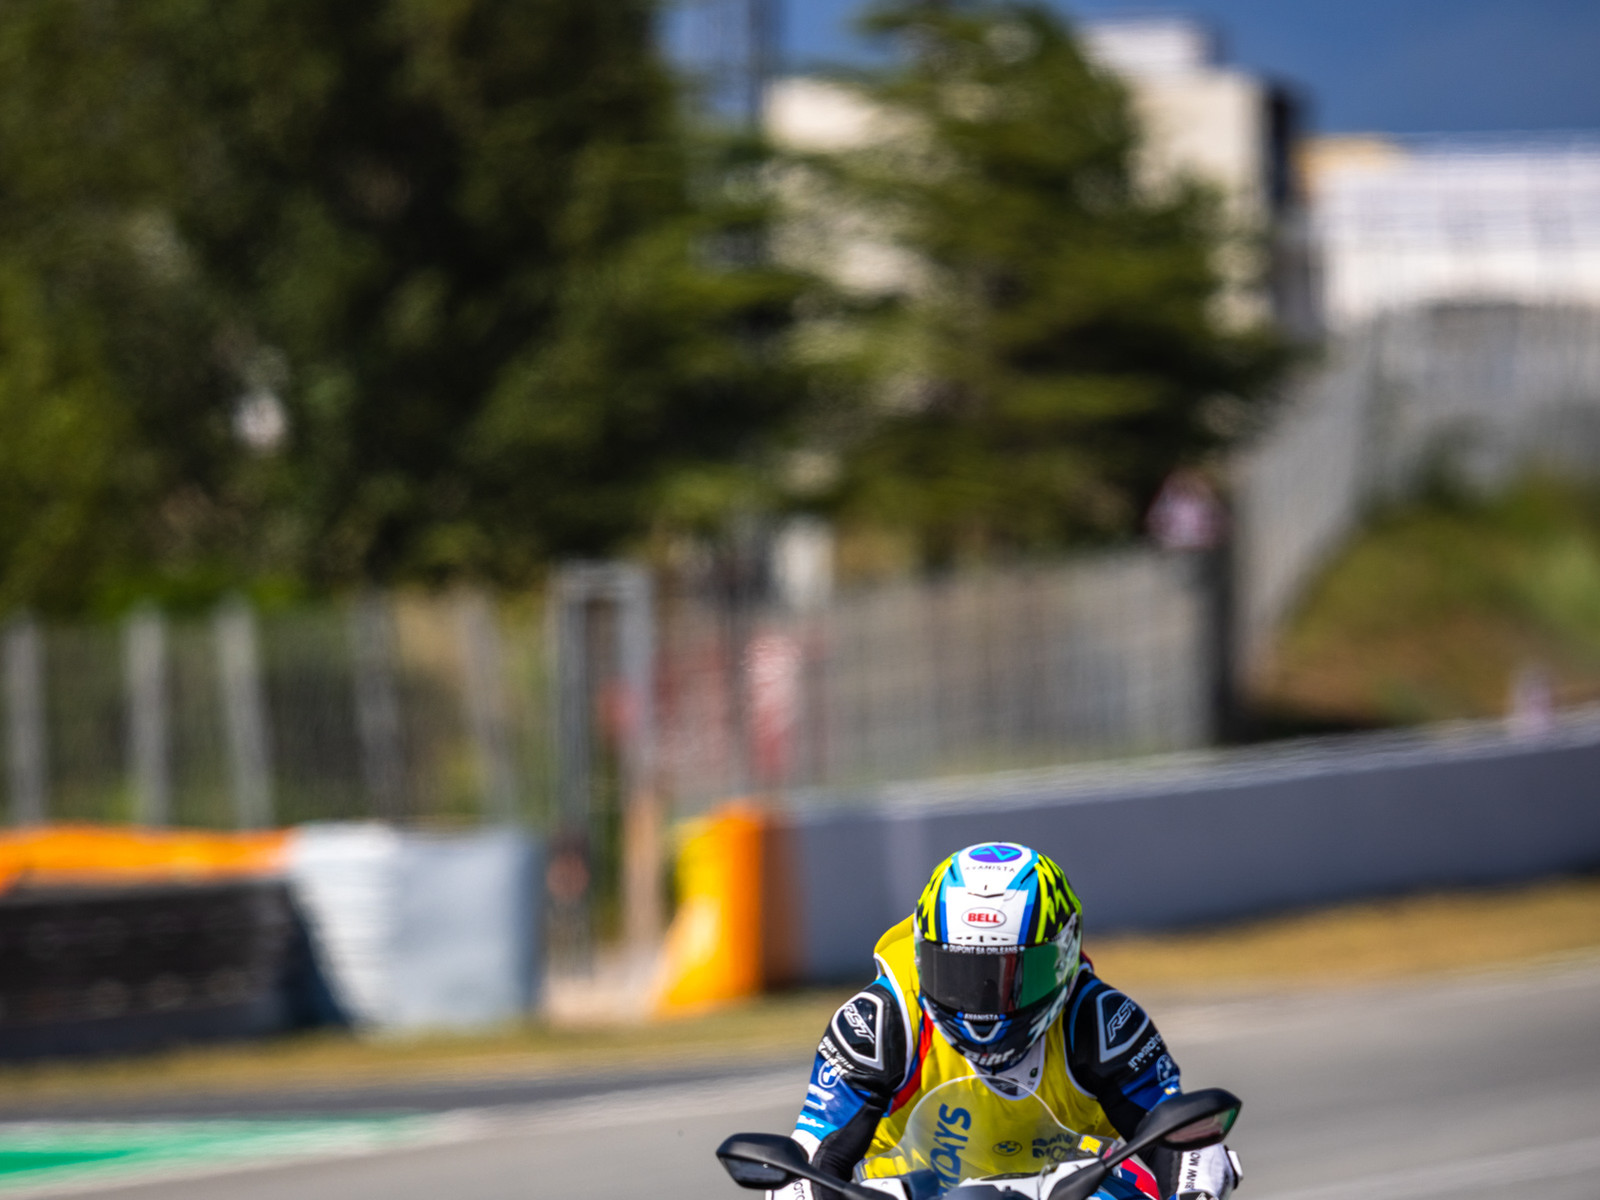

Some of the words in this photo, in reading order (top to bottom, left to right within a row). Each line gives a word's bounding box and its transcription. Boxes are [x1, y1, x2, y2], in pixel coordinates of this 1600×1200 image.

[967, 912, 1000, 924] BELL
[949, 944, 975, 954] DUPONT
[844, 1002, 875, 1044] RST
[1107, 997, 1137, 1043] RST
